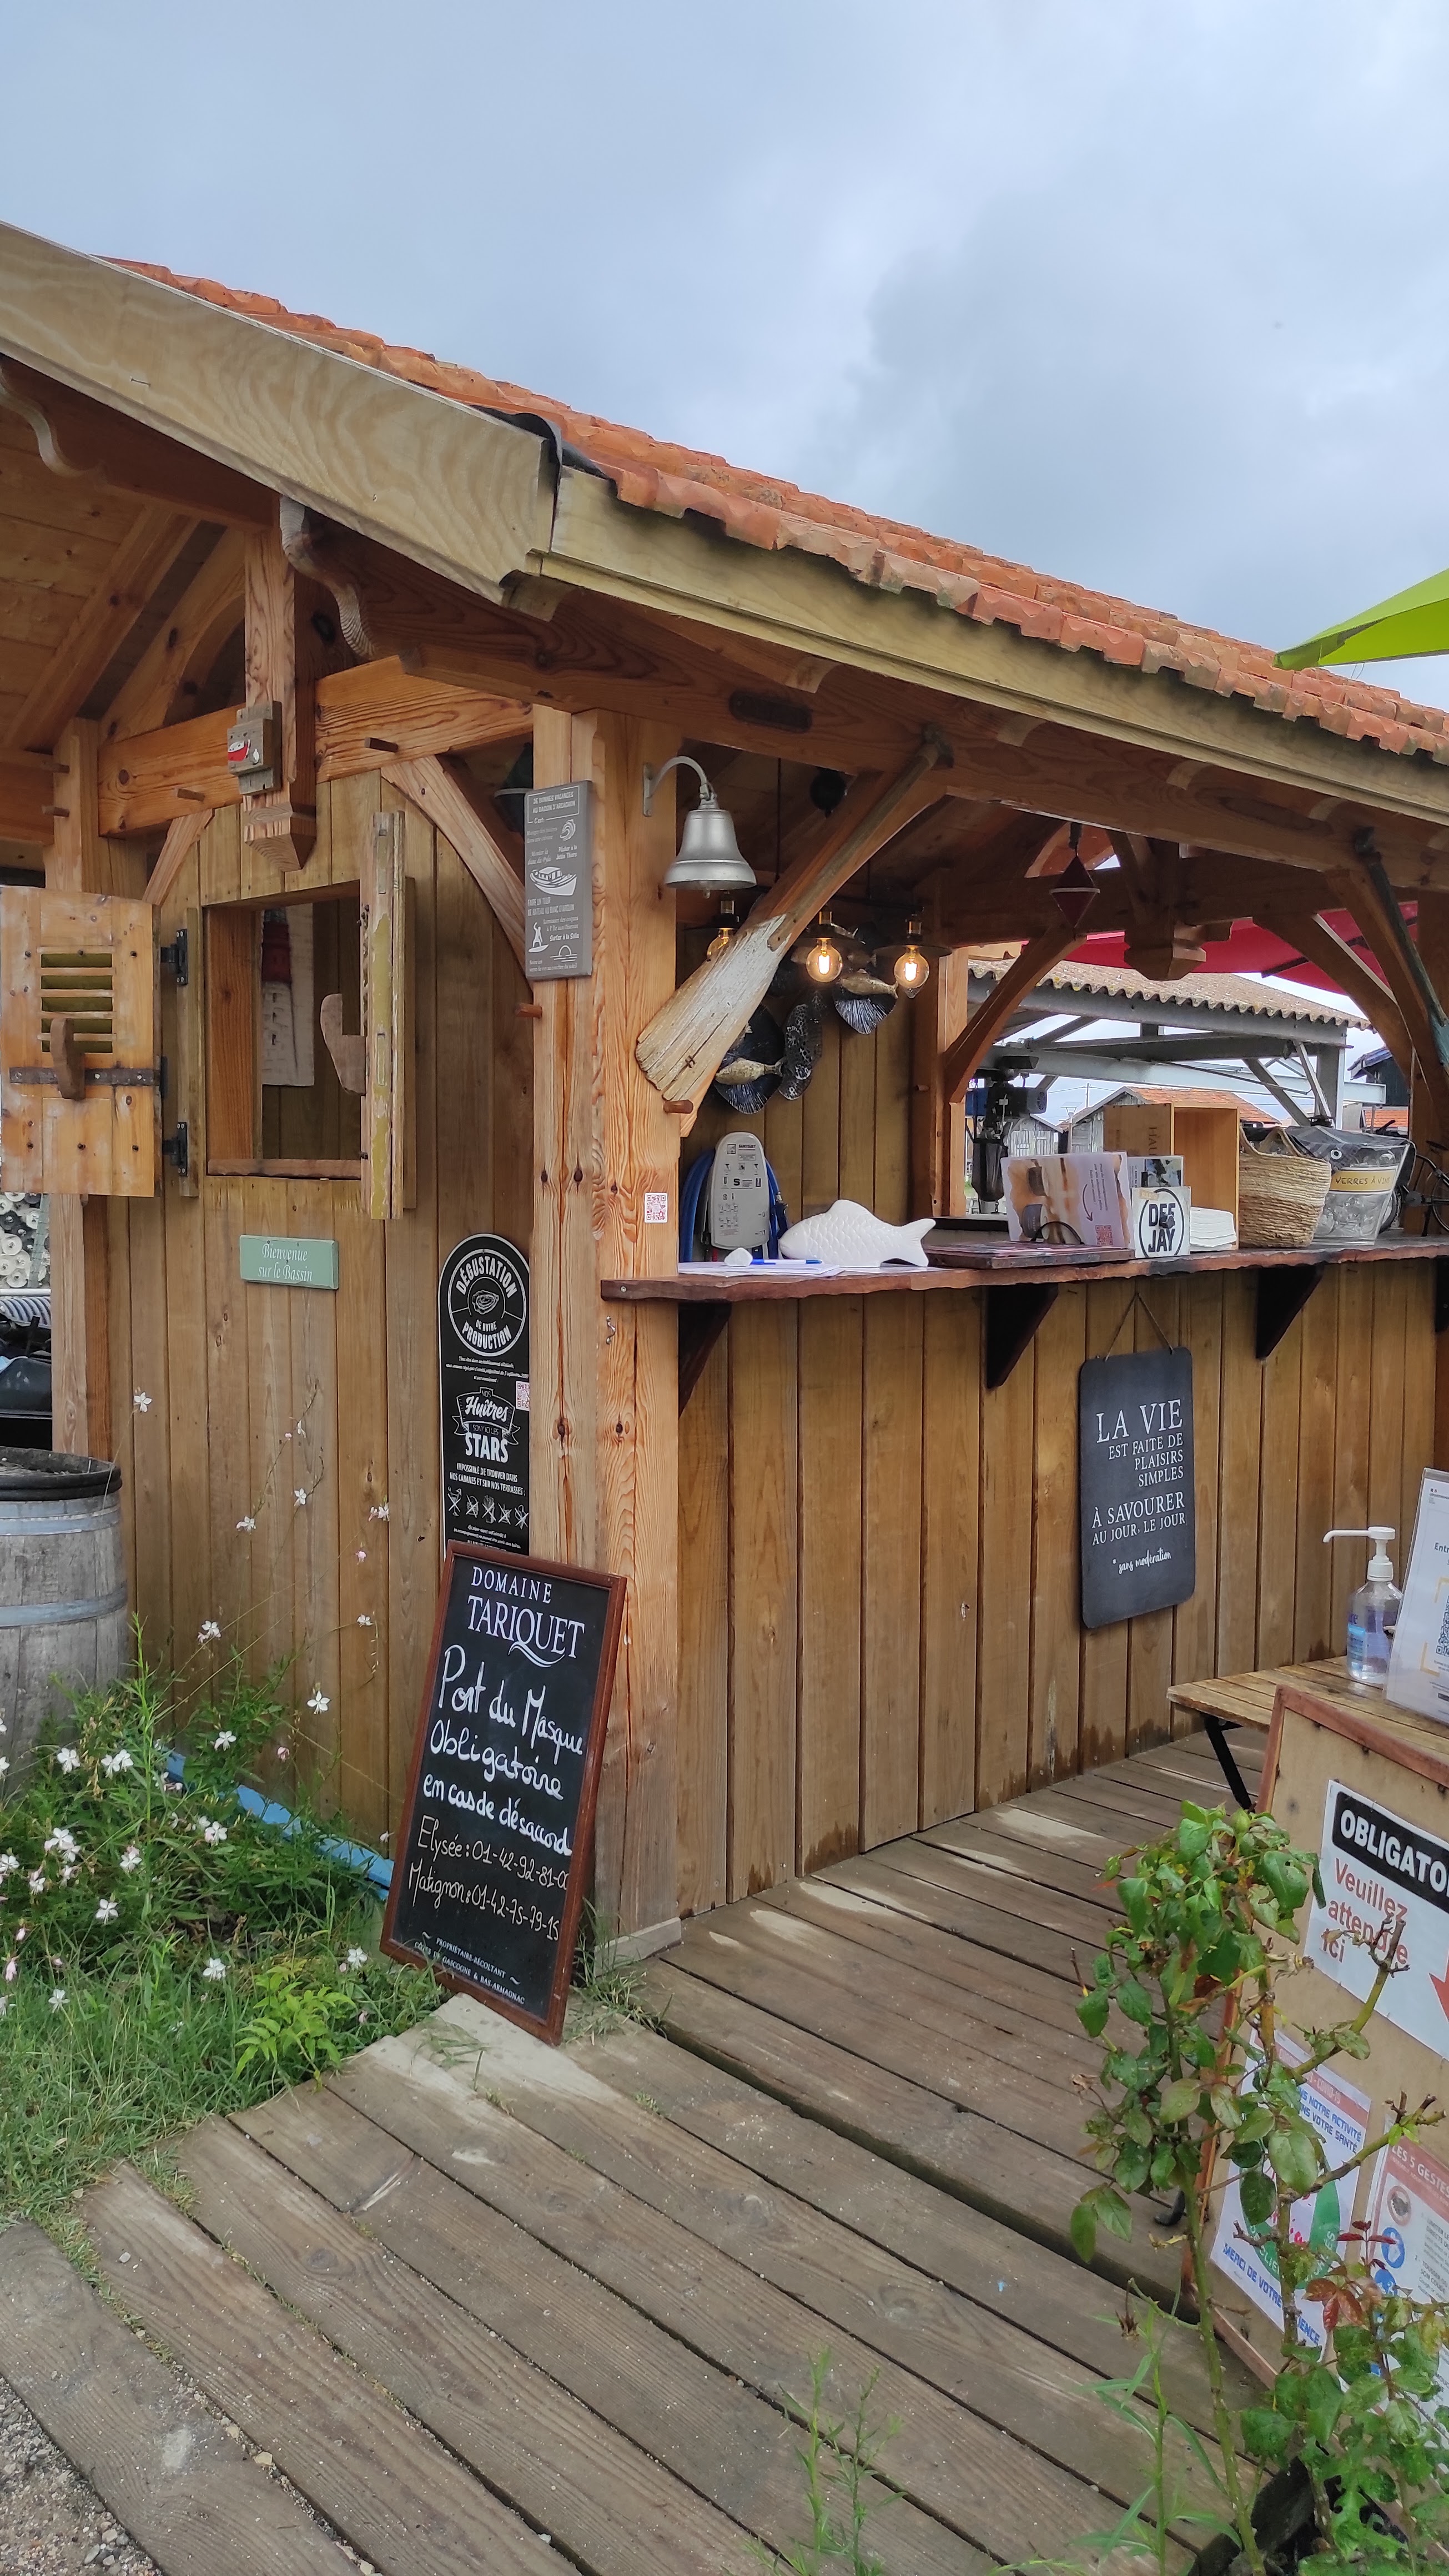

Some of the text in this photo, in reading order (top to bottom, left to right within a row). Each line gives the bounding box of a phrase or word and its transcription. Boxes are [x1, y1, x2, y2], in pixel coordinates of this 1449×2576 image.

[1335, 1176, 1368, 1185] VERRES
[1371, 1175, 1376, 1184] À
[262, 1242, 308, 1261] Bienvenue
[1148, 1228, 1176, 1252] JAY
[258, 1261, 313, 1282] sur le Bassin
[456, 1256, 517, 1298] DÉGUSTATION
[462, 1320, 512, 1350] PRODUCTION
[475, 1319, 497, 1332] DE NOTRE
[465, 1396, 509, 1422] Huîtres
[1096, 1398, 1184, 1445] LA VIE
[465, 1432, 509, 1463] STARS
[1108, 1432, 1184, 1461] EST FAITE DE
[1134, 1449, 1184, 1471] PLAISIRS
[449, 1472, 458, 1481] NOS
[458, 1473, 476, 1485] CABANES
[477, 1477, 482, 1486] ET
[482, 1479, 491, 1488] SUR
[491, 1481, 500, 1490] NOS
[500, 1483, 524, 1496] TERRASSES
[457, 1462, 518, 1483] IMPOSSIBLE DE TROUVER DANS
[1138, 1466, 1184, 1488] SIMPLES
[1091, 1491, 1185, 1530] À SAVOURER
[1092, 1529, 1107, 1546] AU
[1143, 1518, 1156, 1534] LE
[1159, 1512, 1186, 1531] JOUR
[1118, 1547, 1172, 1574] sans modération
[471, 1566, 552, 1604] DOMAINE
[467, 1594, 586, 1668] TARIQUET
[438, 1644, 583, 1765] Port du Masque
[430, 1719, 565, 1800] Obligatoire
[423, 1773, 572, 1856] en cas de désaccord
[1340, 1809, 1449, 1898] OBLIGATO
[1335, 1858, 1408, 1921] Veuillez
[471, 1884, 560, 1941] 01-42-75-79-15
[1328, 1899, 1408, 1965] attende
[436, 1937, 506, 1979] PROPRIÉTAIRE-RÉCOLTANT
[442, 1956, 472, 1976] GASCOGNE
[474, 1971, 479, 1980] &
[480, 1974, 525, 2005] BAS-ARMAGNAC
[1309, 2096, 1331, 2119] NOTRE
[1331, 2113, 1362, 2142] ACTIVITÉ
[1312, 2112, 1358, 2154] VOTRE SANTÉ
[1392, 2145, 1408, 2162] LES
[1409, 2156, 1416, 2169] 5
[1222, 2242, 1246, 2271] MERCI
[1246, 2265, 1257, 2283] DE
[1259, 2276, 1282, 2308] VOTRE
